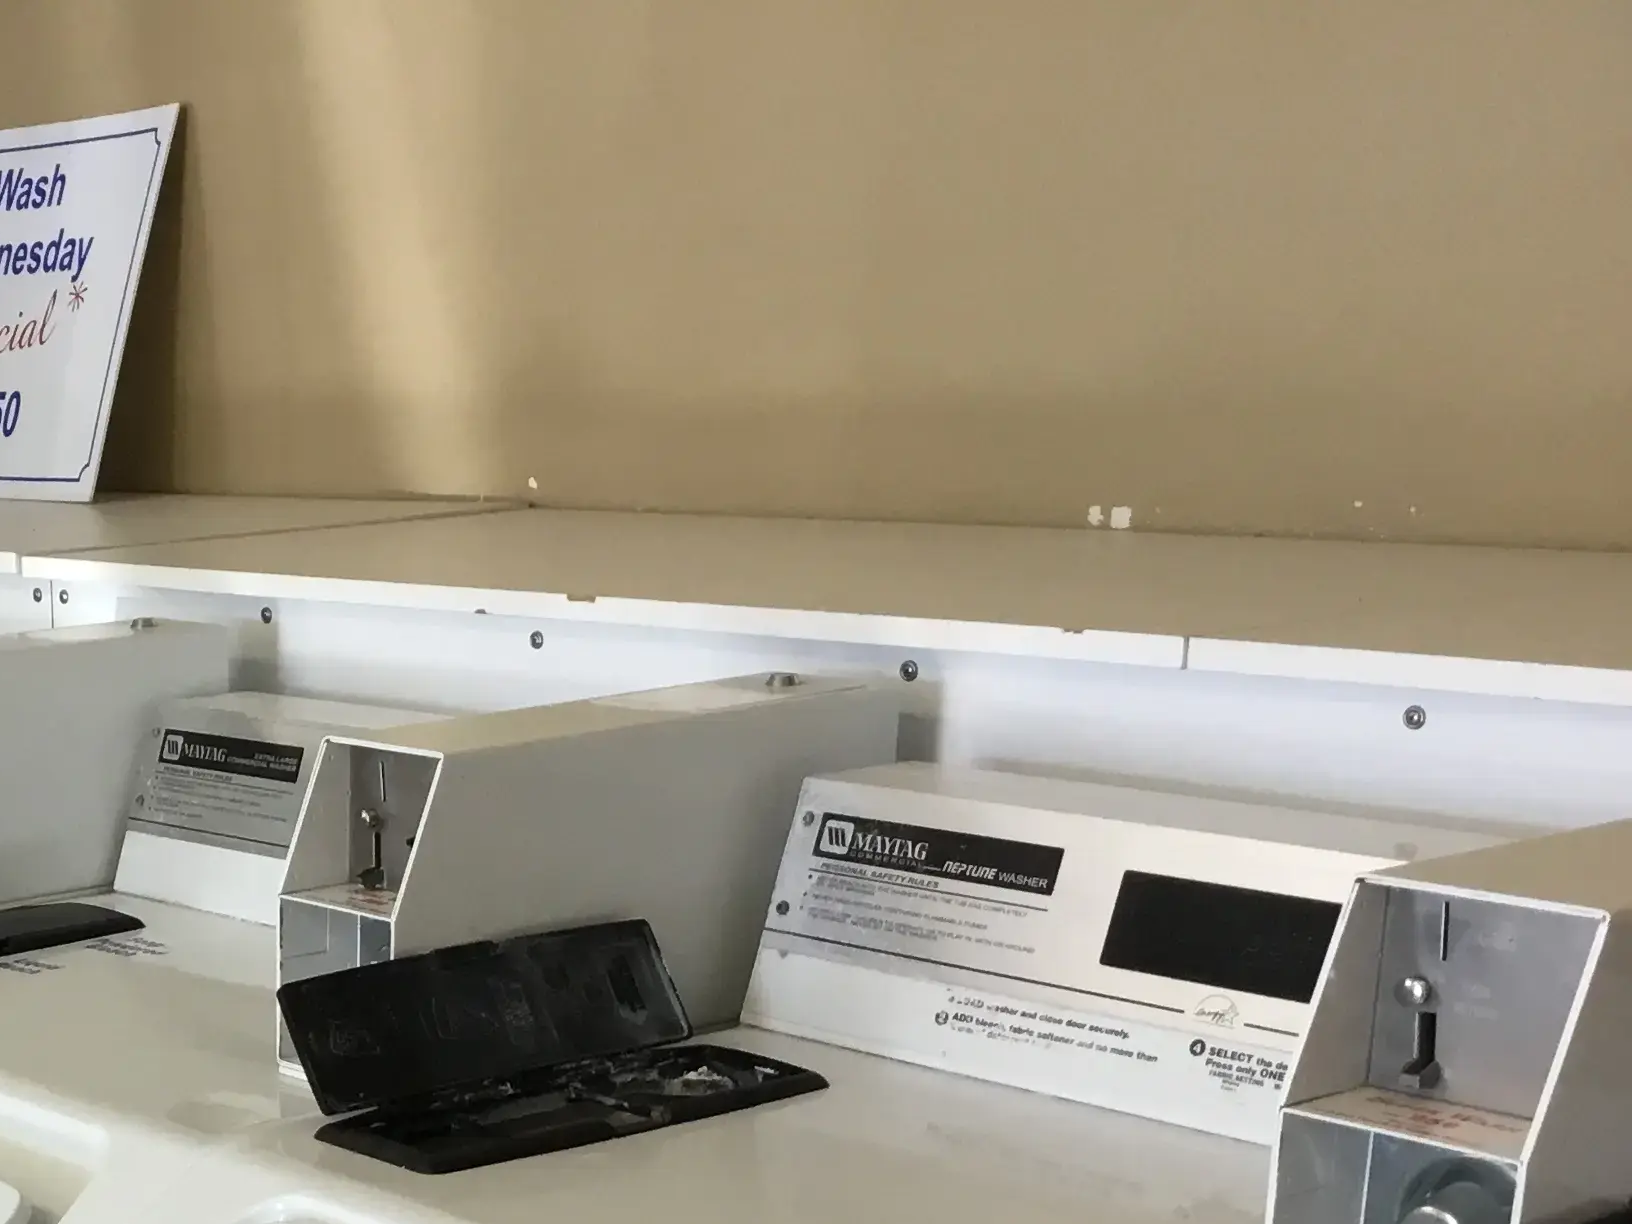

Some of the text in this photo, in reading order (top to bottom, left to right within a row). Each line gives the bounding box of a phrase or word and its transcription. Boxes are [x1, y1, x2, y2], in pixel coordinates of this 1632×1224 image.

[183, 743, 228, 763] MAYTAG
[851, 832, 929, 861] MAYTAG
[850, 851, 922, 868] COMMERCIAL
[870, 871, 907, 883] SAFETY
[998, 871, 1048, 889] WASHER
[952, 1012, 973, 1023] ADD
[1208, 1046, 1254, 1063] SELECT
[1256, 1058, 1272, 1068] the
[1275, 1061, 1288, 1071] de
[1205, 1058, 1286, 1082] Press only ONE
